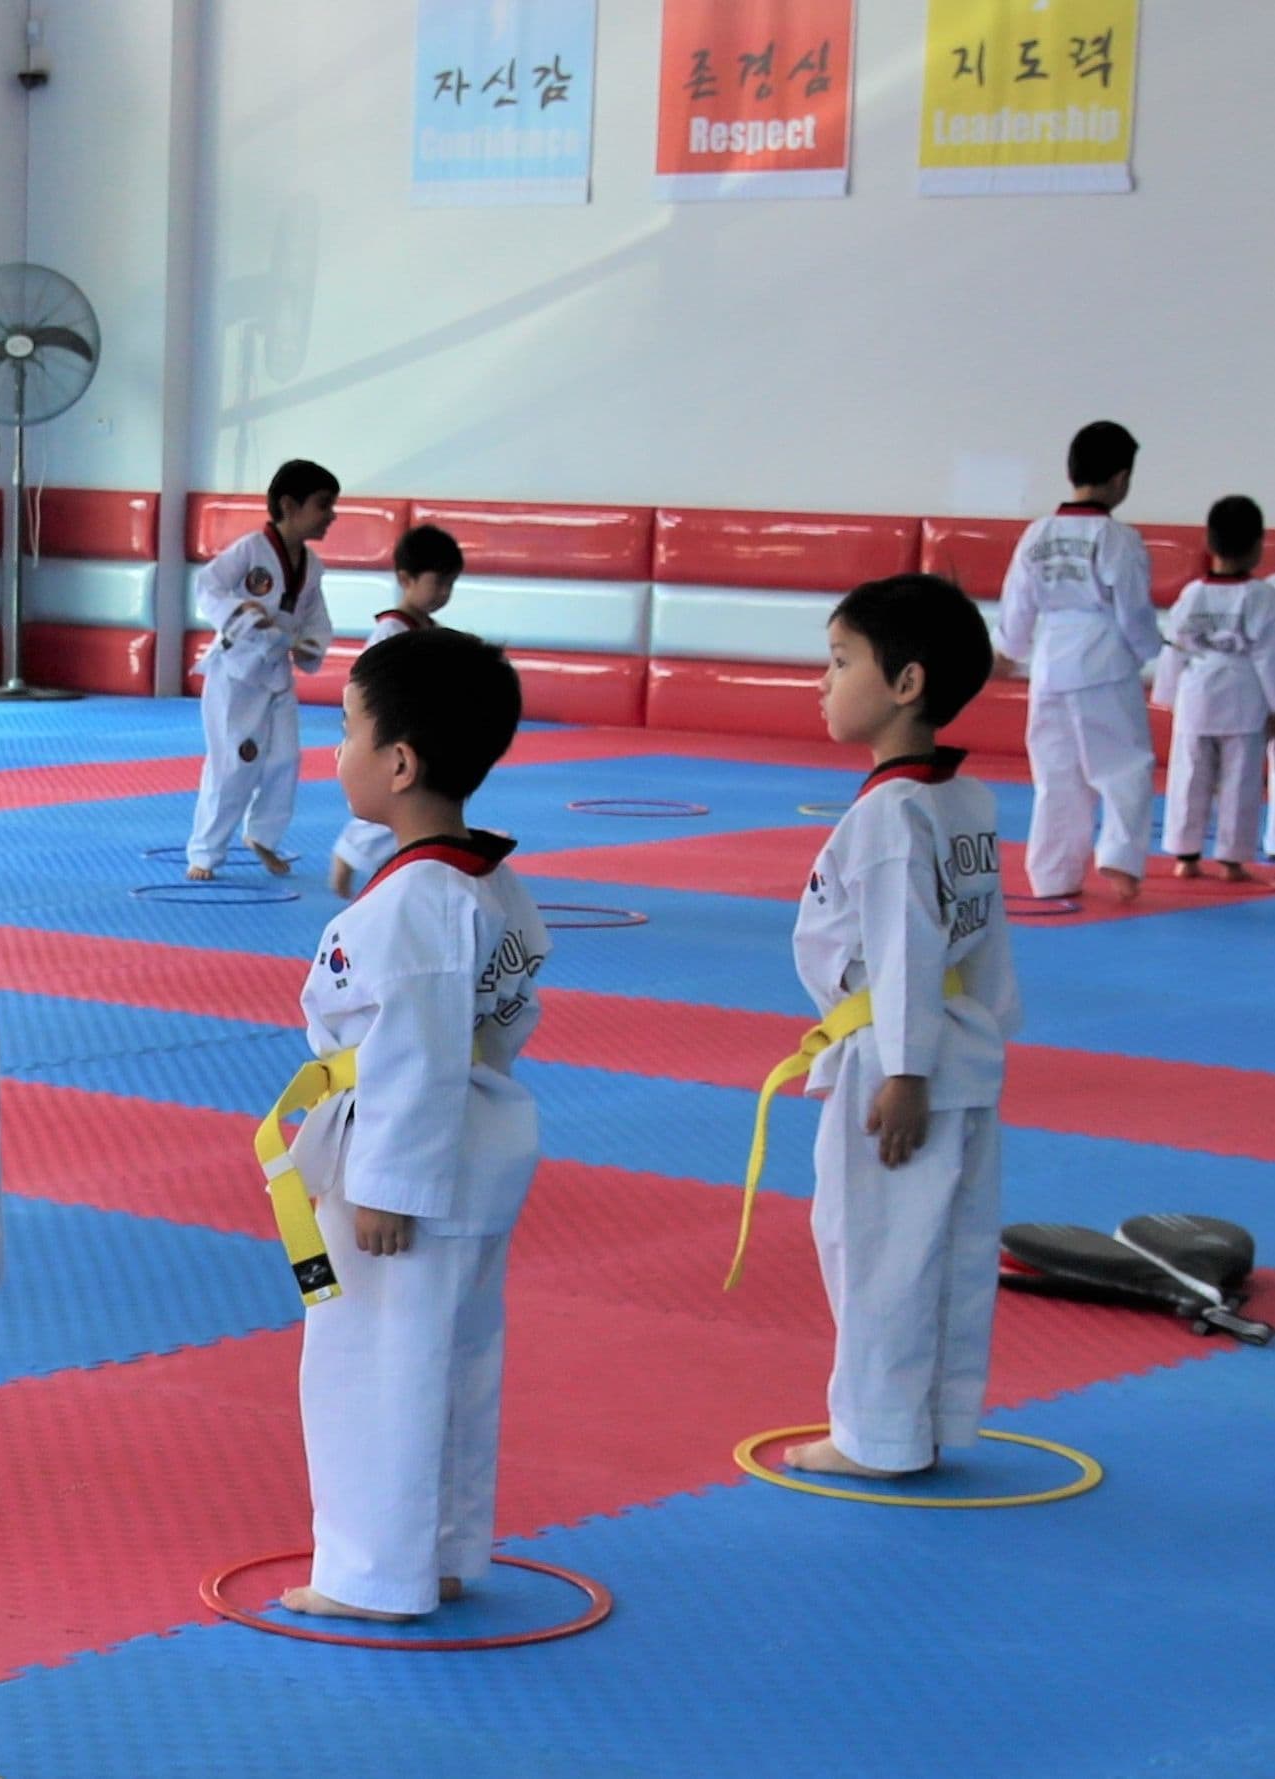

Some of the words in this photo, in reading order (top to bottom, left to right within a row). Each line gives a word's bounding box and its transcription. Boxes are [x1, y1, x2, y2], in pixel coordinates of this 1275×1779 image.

[433, 54, 573, 110] 자신감
[683, 41, 830, 99] 존경심
[951, 26, 1113, 88] 지도력
[688, 113, 816, 155] Respect
[933, 101, 1121, 146] Leadership
